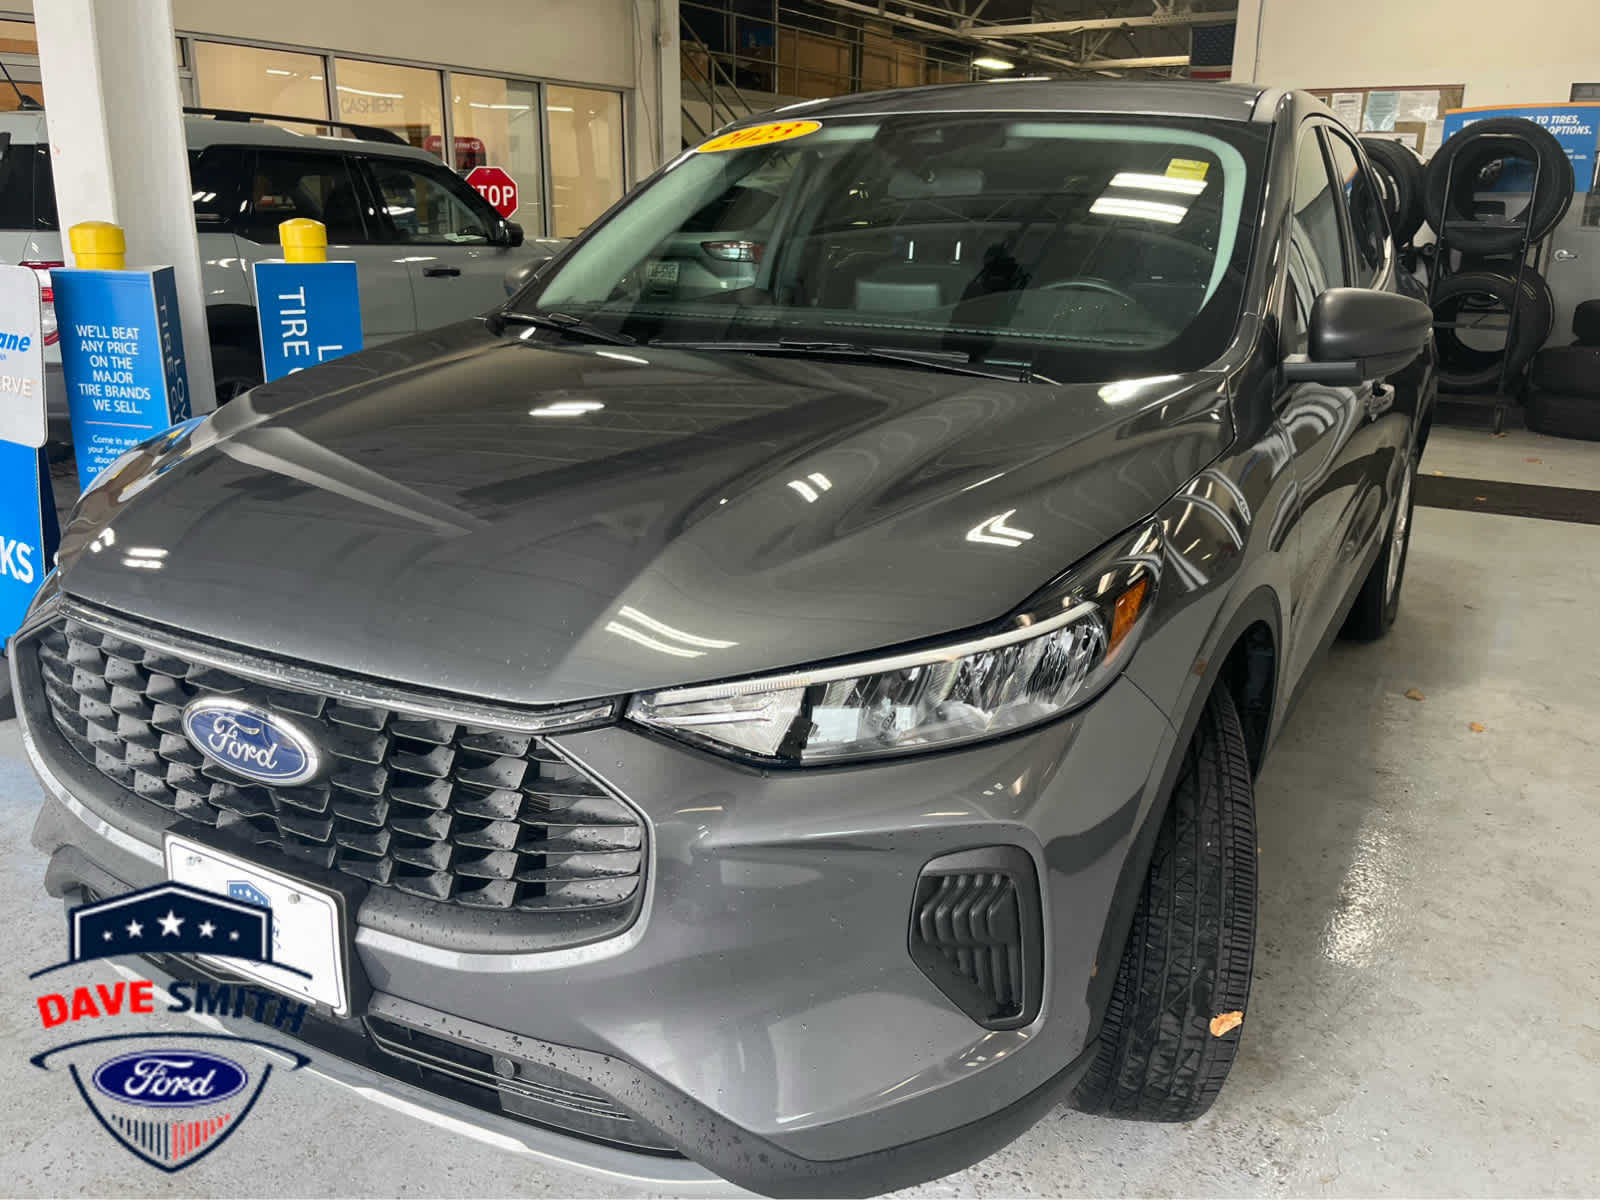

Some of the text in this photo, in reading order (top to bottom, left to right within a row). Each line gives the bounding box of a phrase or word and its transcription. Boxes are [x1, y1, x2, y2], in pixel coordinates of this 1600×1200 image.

[1552, 114, 1580, 125] TIRES,
[472, 185, 514, 206] TOP
[278, 286, 310, 357] TIRE
[76, 324, 140, 340] WE'LL BEAT
[160, 296, 176, 376] TIRE
[81, 340, 139, 355] ANY PRICE
[89, 355, 134, 370] ON THE
[93, 369, 134, 384] MAJOR
[78, 383, 151, 400] TIRE BRANDS
[93, 399, 113, 412] WE
[92, 435, 114, 445] Come
[208, 715, 279, 769] Ford
